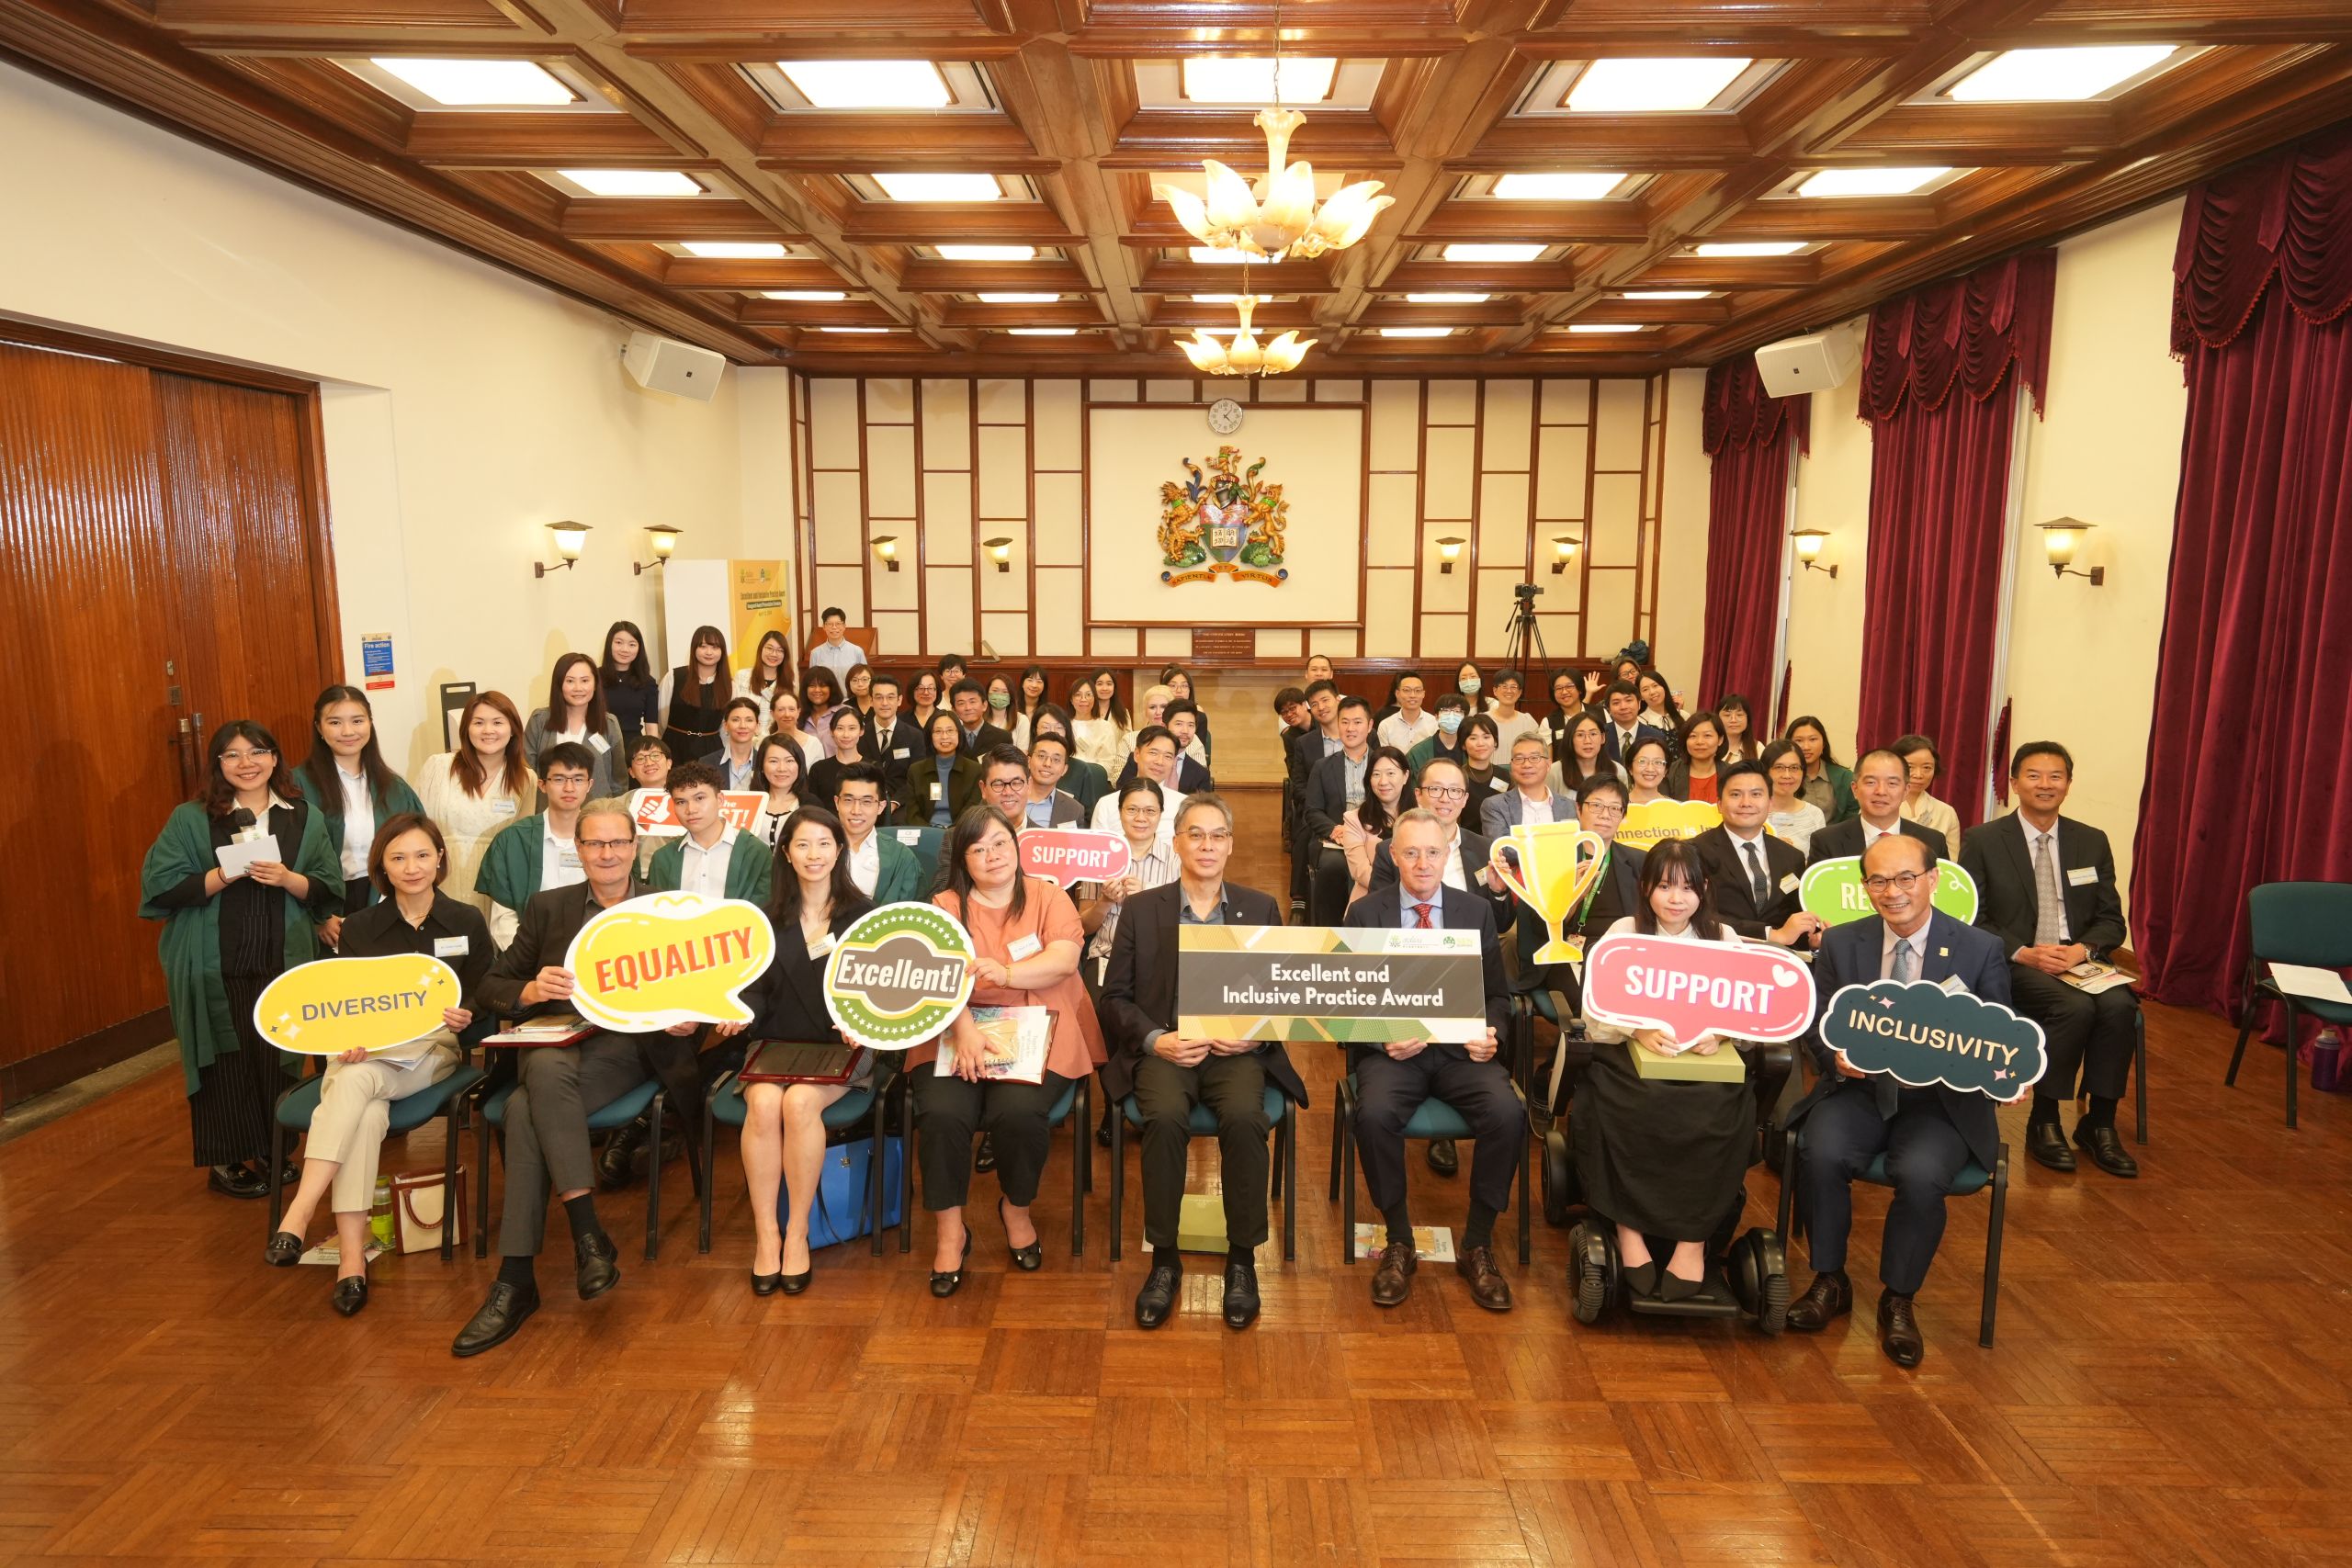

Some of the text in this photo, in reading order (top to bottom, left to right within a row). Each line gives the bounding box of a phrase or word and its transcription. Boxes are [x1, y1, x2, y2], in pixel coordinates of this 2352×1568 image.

[718, 808, 750, 828] ST!
[1612, 826, 1680, 840] nnection
[1031, 845, 1111, 868] SUPPORT
[594, 926, 752, 993] EQUALITY
[837, 953, 961, 993] Excellent!
[1271, 963, 1389, 983] Excellent and
[1223, 986, 1443, 1007] Inclusive Practice Award
[1624, 964, 1775, 1015] SUPPORT
[301, 990, 427, 1021] DIVERSITY
[1849, 1009, 2019, 1066] INCLUSIVITY
